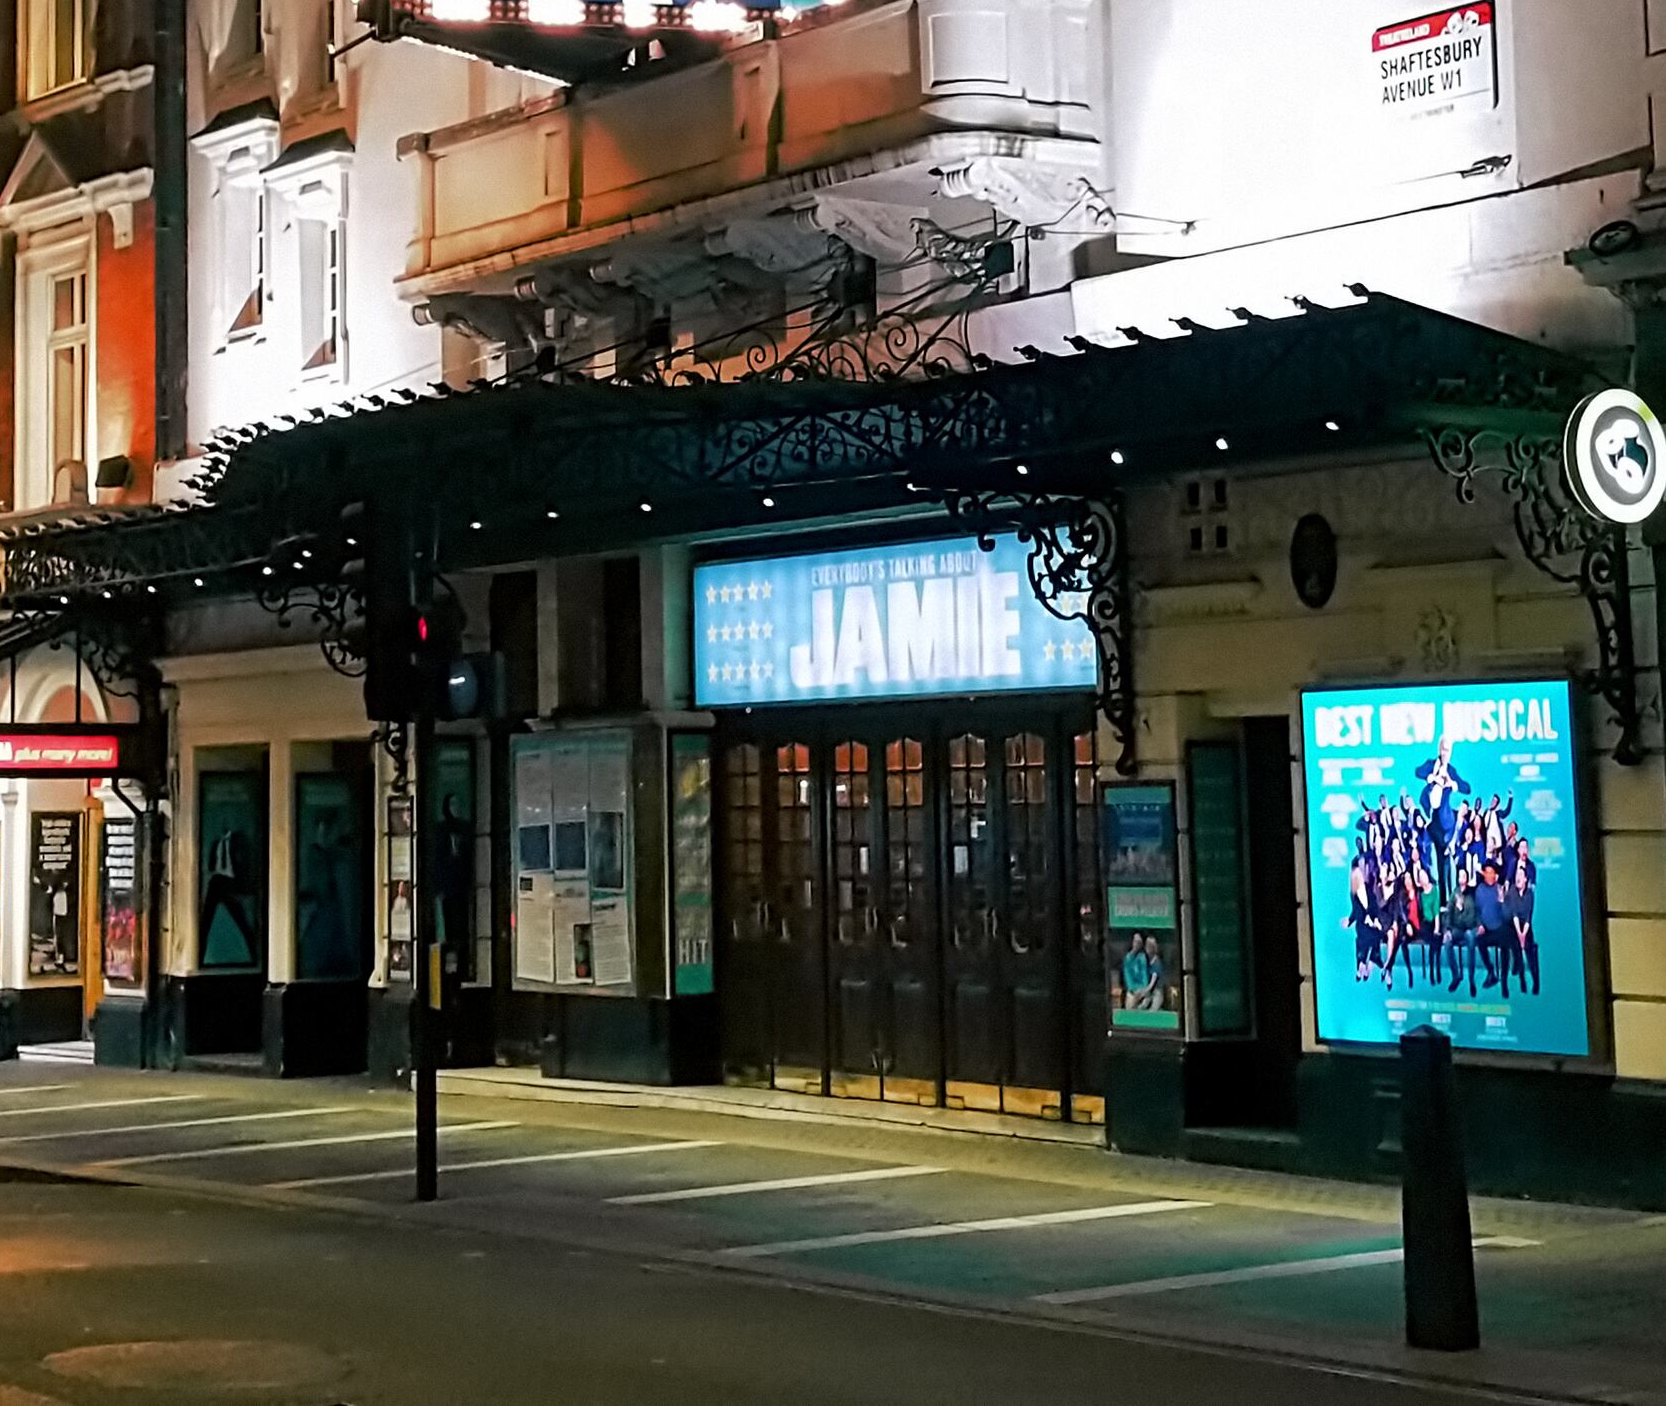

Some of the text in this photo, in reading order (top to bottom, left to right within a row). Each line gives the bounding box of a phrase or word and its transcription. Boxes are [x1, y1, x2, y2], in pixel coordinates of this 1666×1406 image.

[1381, 35, 1483, 80] SHAFTESBURY
[1382, 68, 1462, 104] AVENUE W1
[890, 555, 935, 580] TALKING
[940, 551, 978, 573] ABOUT
[789, 572, 1022, 688] JAMIE
[1314, 698, 1559, 748] BEST NEW MUSICAL
